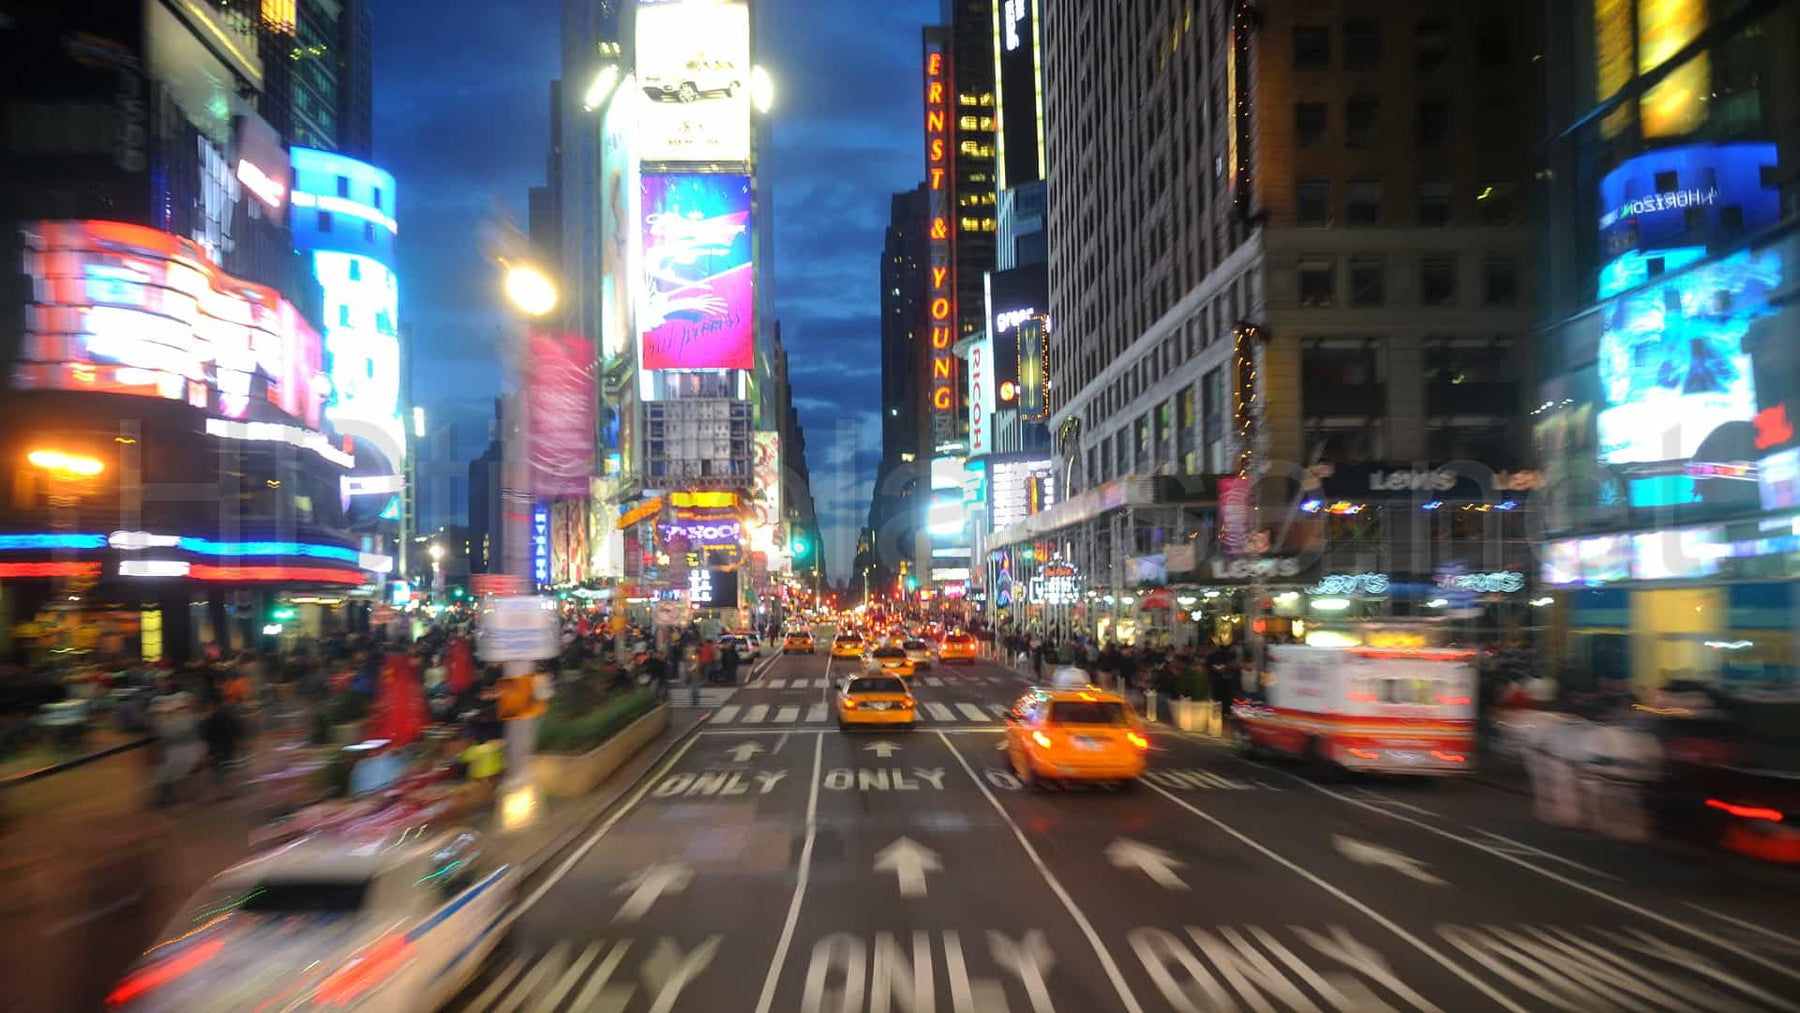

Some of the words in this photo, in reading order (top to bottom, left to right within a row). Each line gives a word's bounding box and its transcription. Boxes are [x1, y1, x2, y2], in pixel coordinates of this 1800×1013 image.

[926, 52, 946, 191] ERNST
[929, 216, 948, 240] &
[930, 266, 952, 410] YOUNG
[969, 346, 983, 450] RICOH
[652, 768, 787, 796] ONLY
[823, 766, 946, 791] ONLY
[800, 928, 1056, 1013] ONLY
